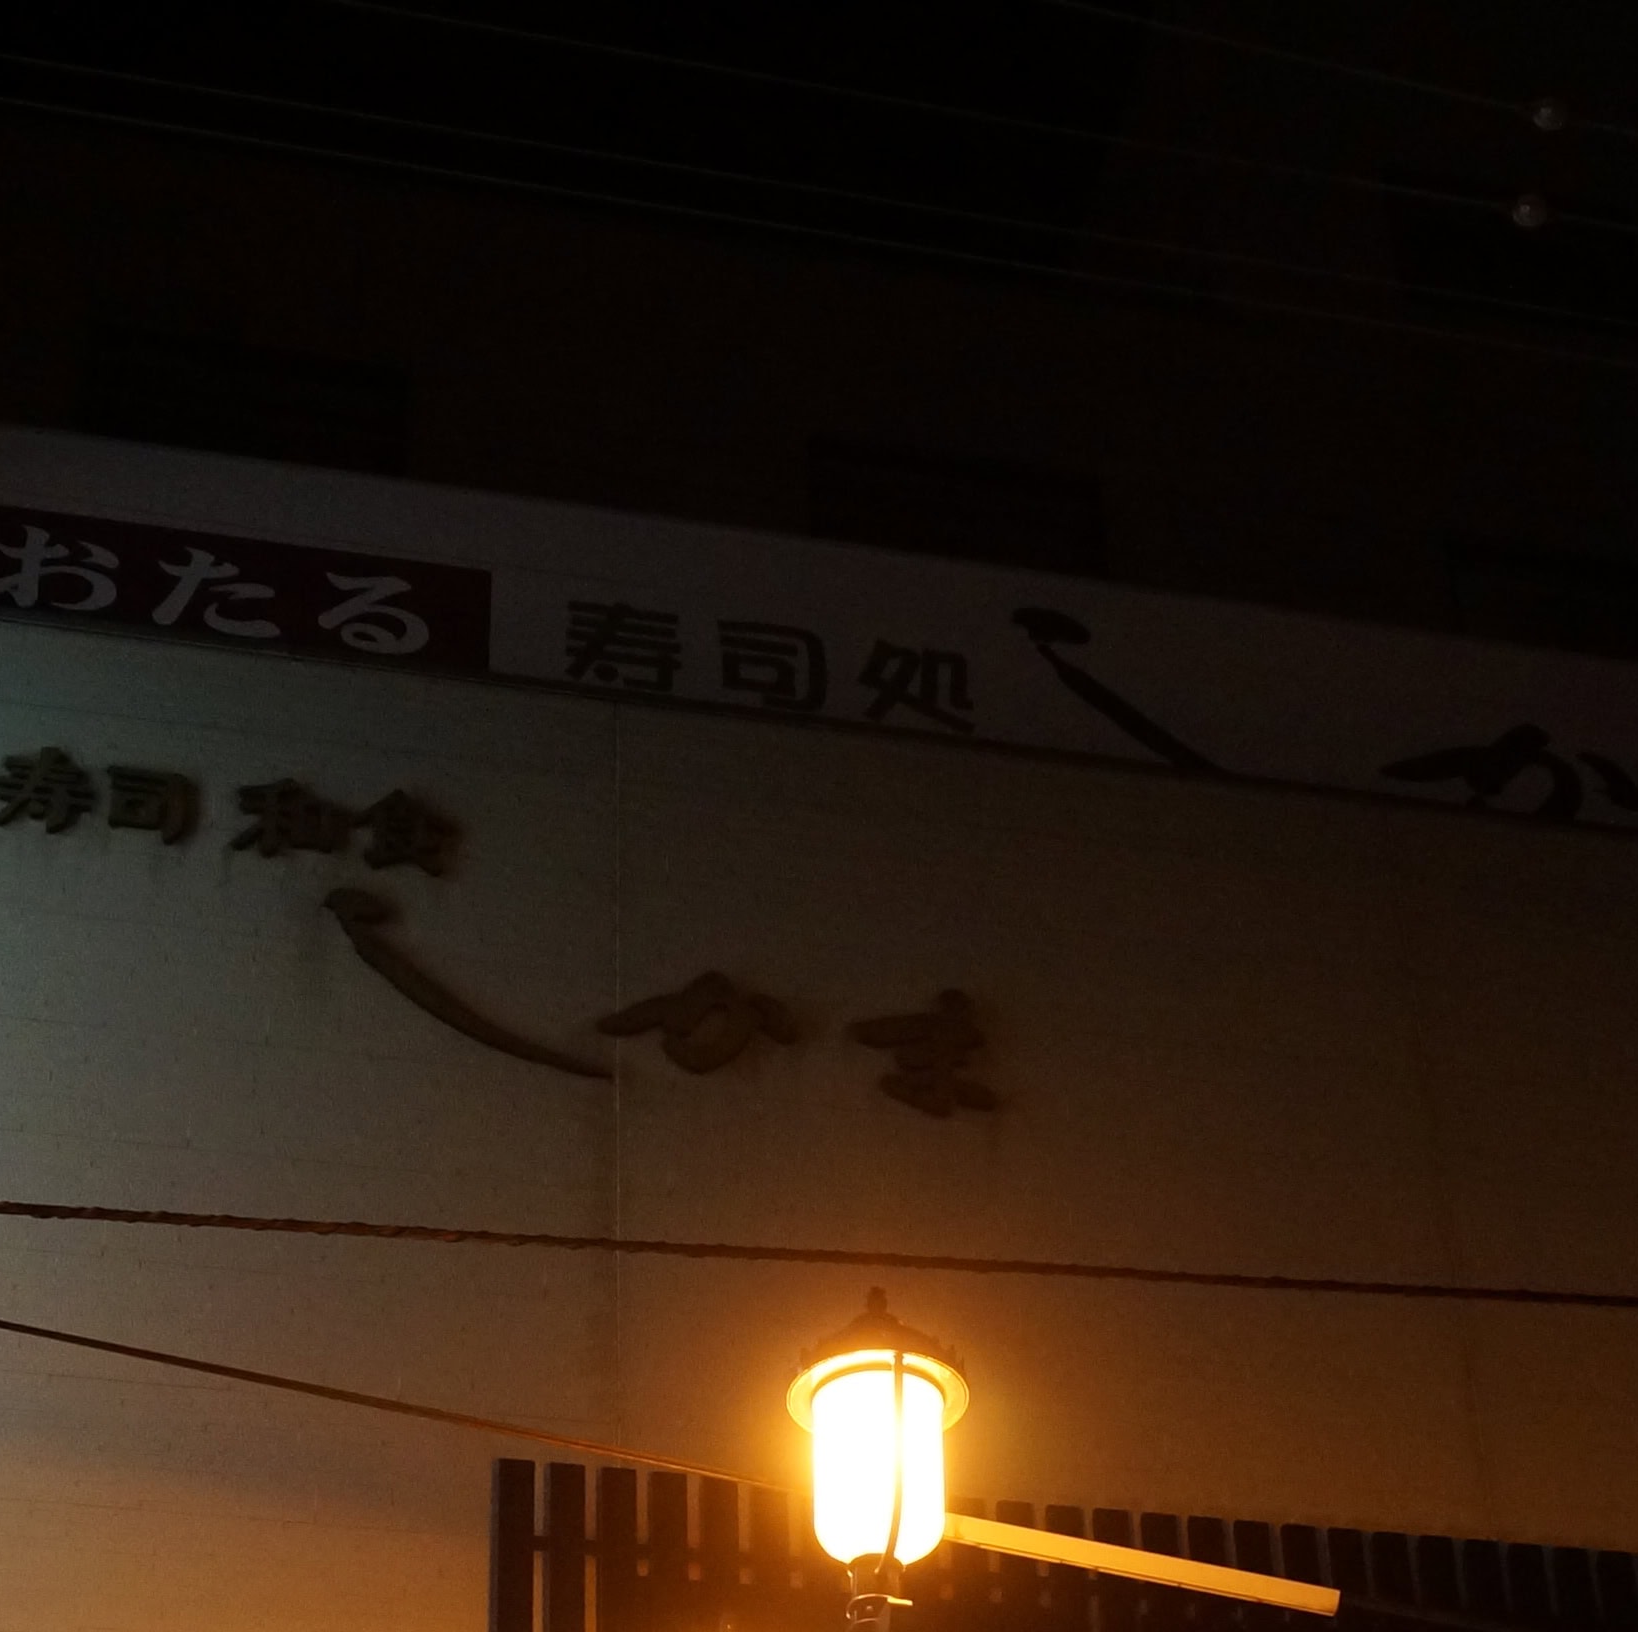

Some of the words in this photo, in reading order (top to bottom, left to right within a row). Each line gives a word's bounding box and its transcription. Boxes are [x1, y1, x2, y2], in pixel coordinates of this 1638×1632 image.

[563, 600, 979, 735] 寿司処
[231, 776, 465, 878] 和食
[323, 886, 1001, 1118] しかま
